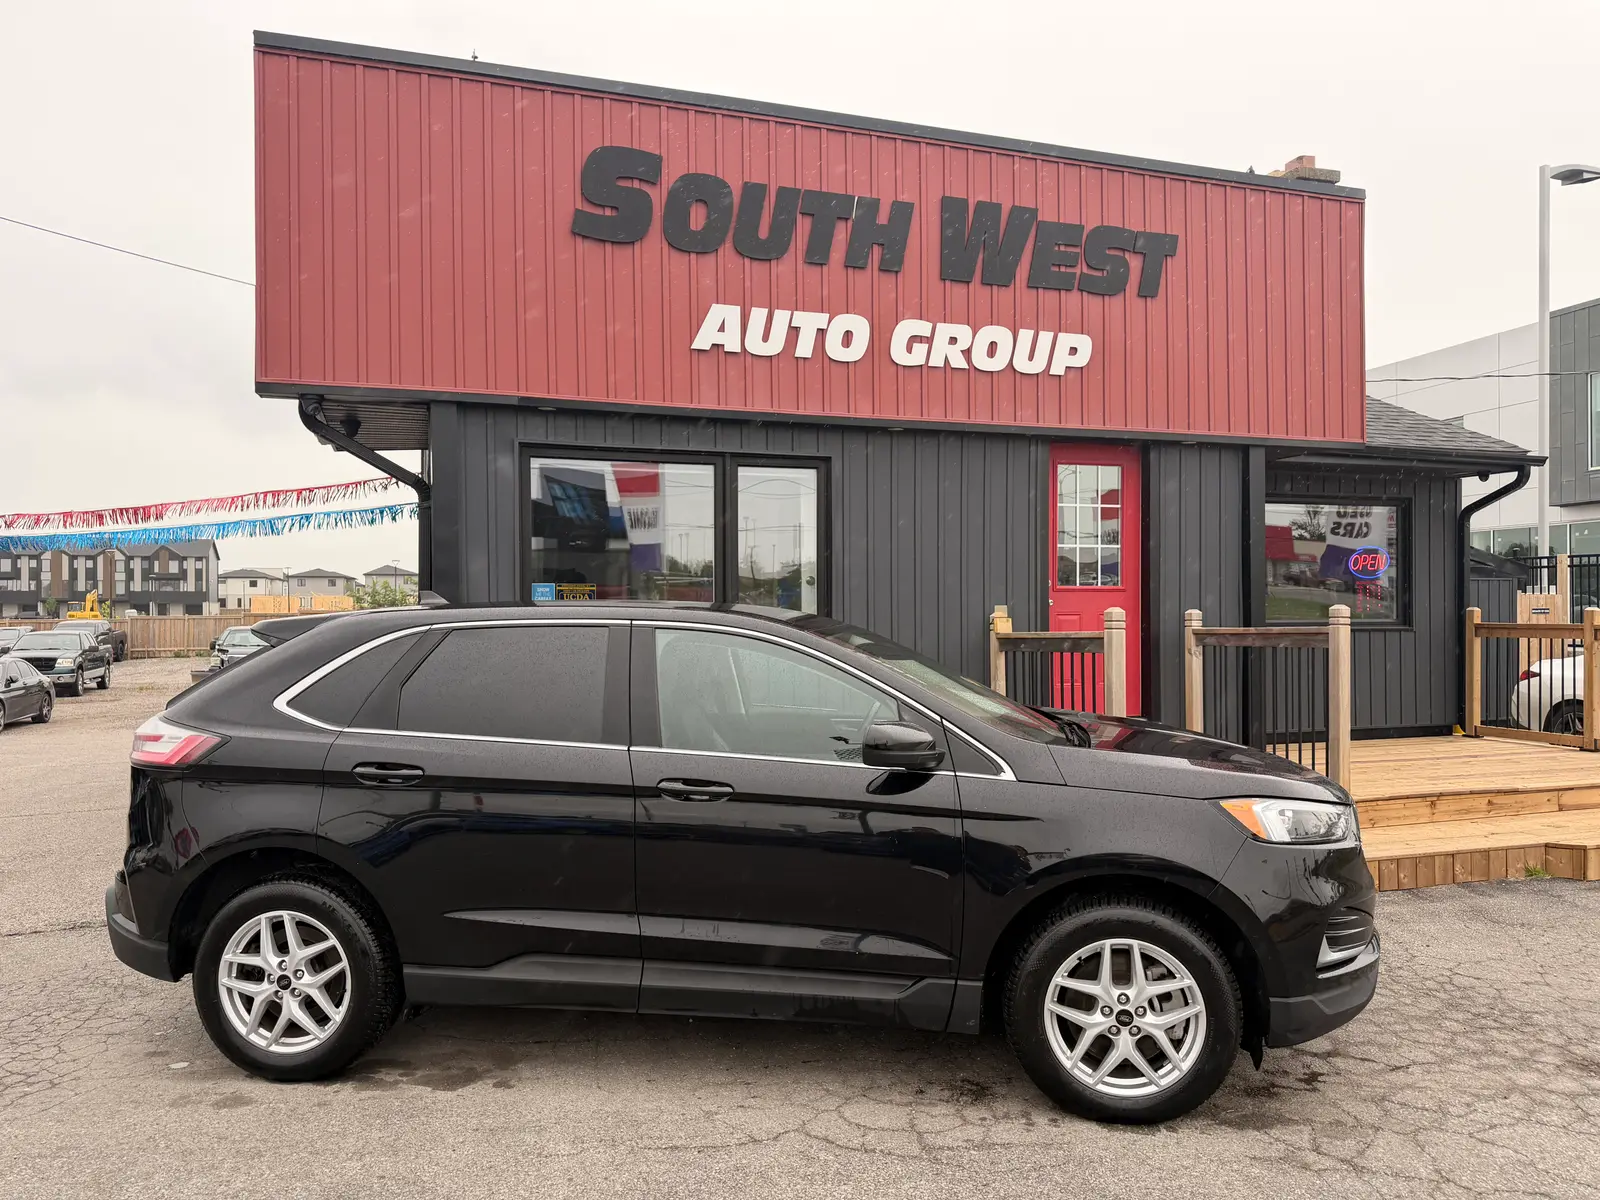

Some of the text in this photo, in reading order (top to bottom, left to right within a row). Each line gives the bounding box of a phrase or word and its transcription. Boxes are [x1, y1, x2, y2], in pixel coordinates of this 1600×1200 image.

[571, 146, 1178, 298] SOUTH WEST
[691, 303, 1093, 377] AUTO GROUP
[1351, 554, 1387, 571] OPEN
